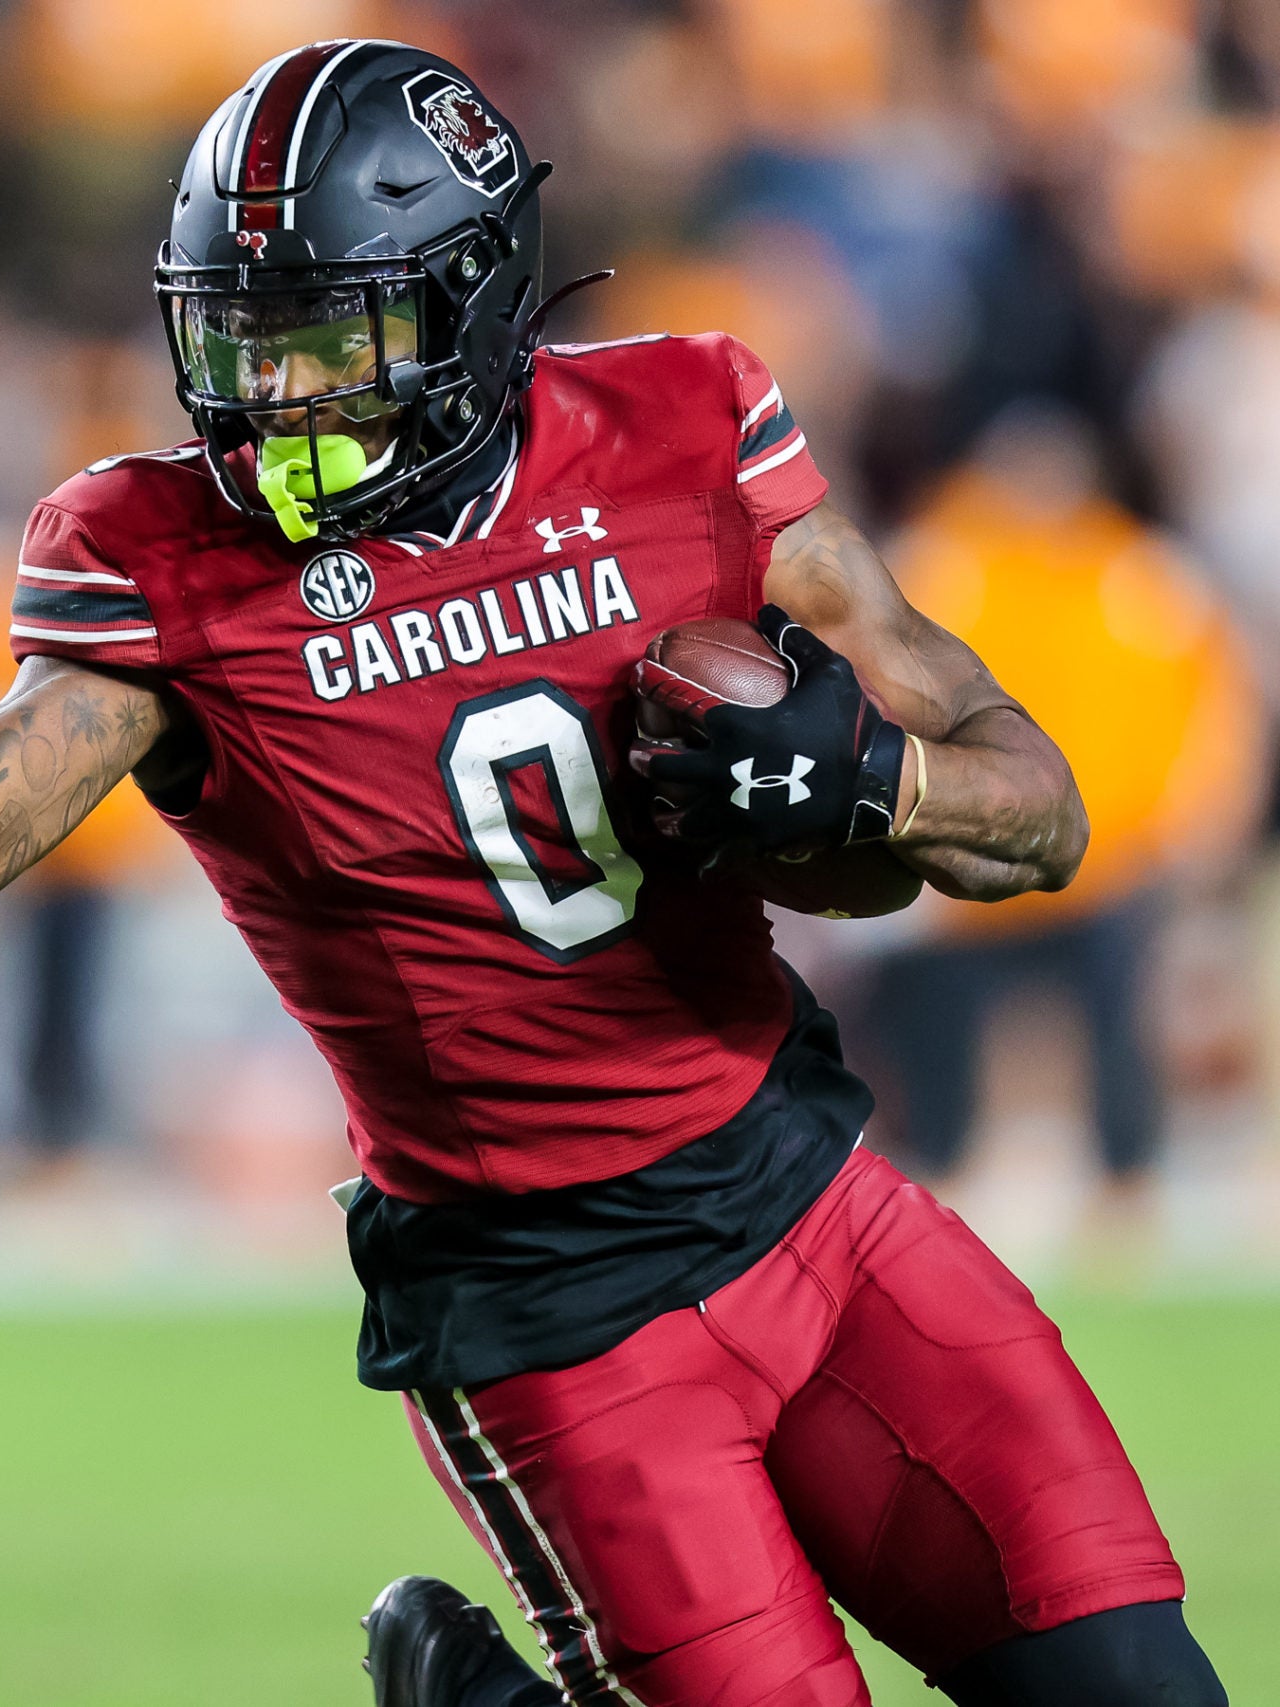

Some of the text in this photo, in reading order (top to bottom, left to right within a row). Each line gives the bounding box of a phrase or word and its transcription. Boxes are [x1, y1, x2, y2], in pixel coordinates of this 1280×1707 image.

[302, 555, 641, 701] CAROLINA
[305, 553, 370, 618] SEC
[437, 676, 645, 965] 0
